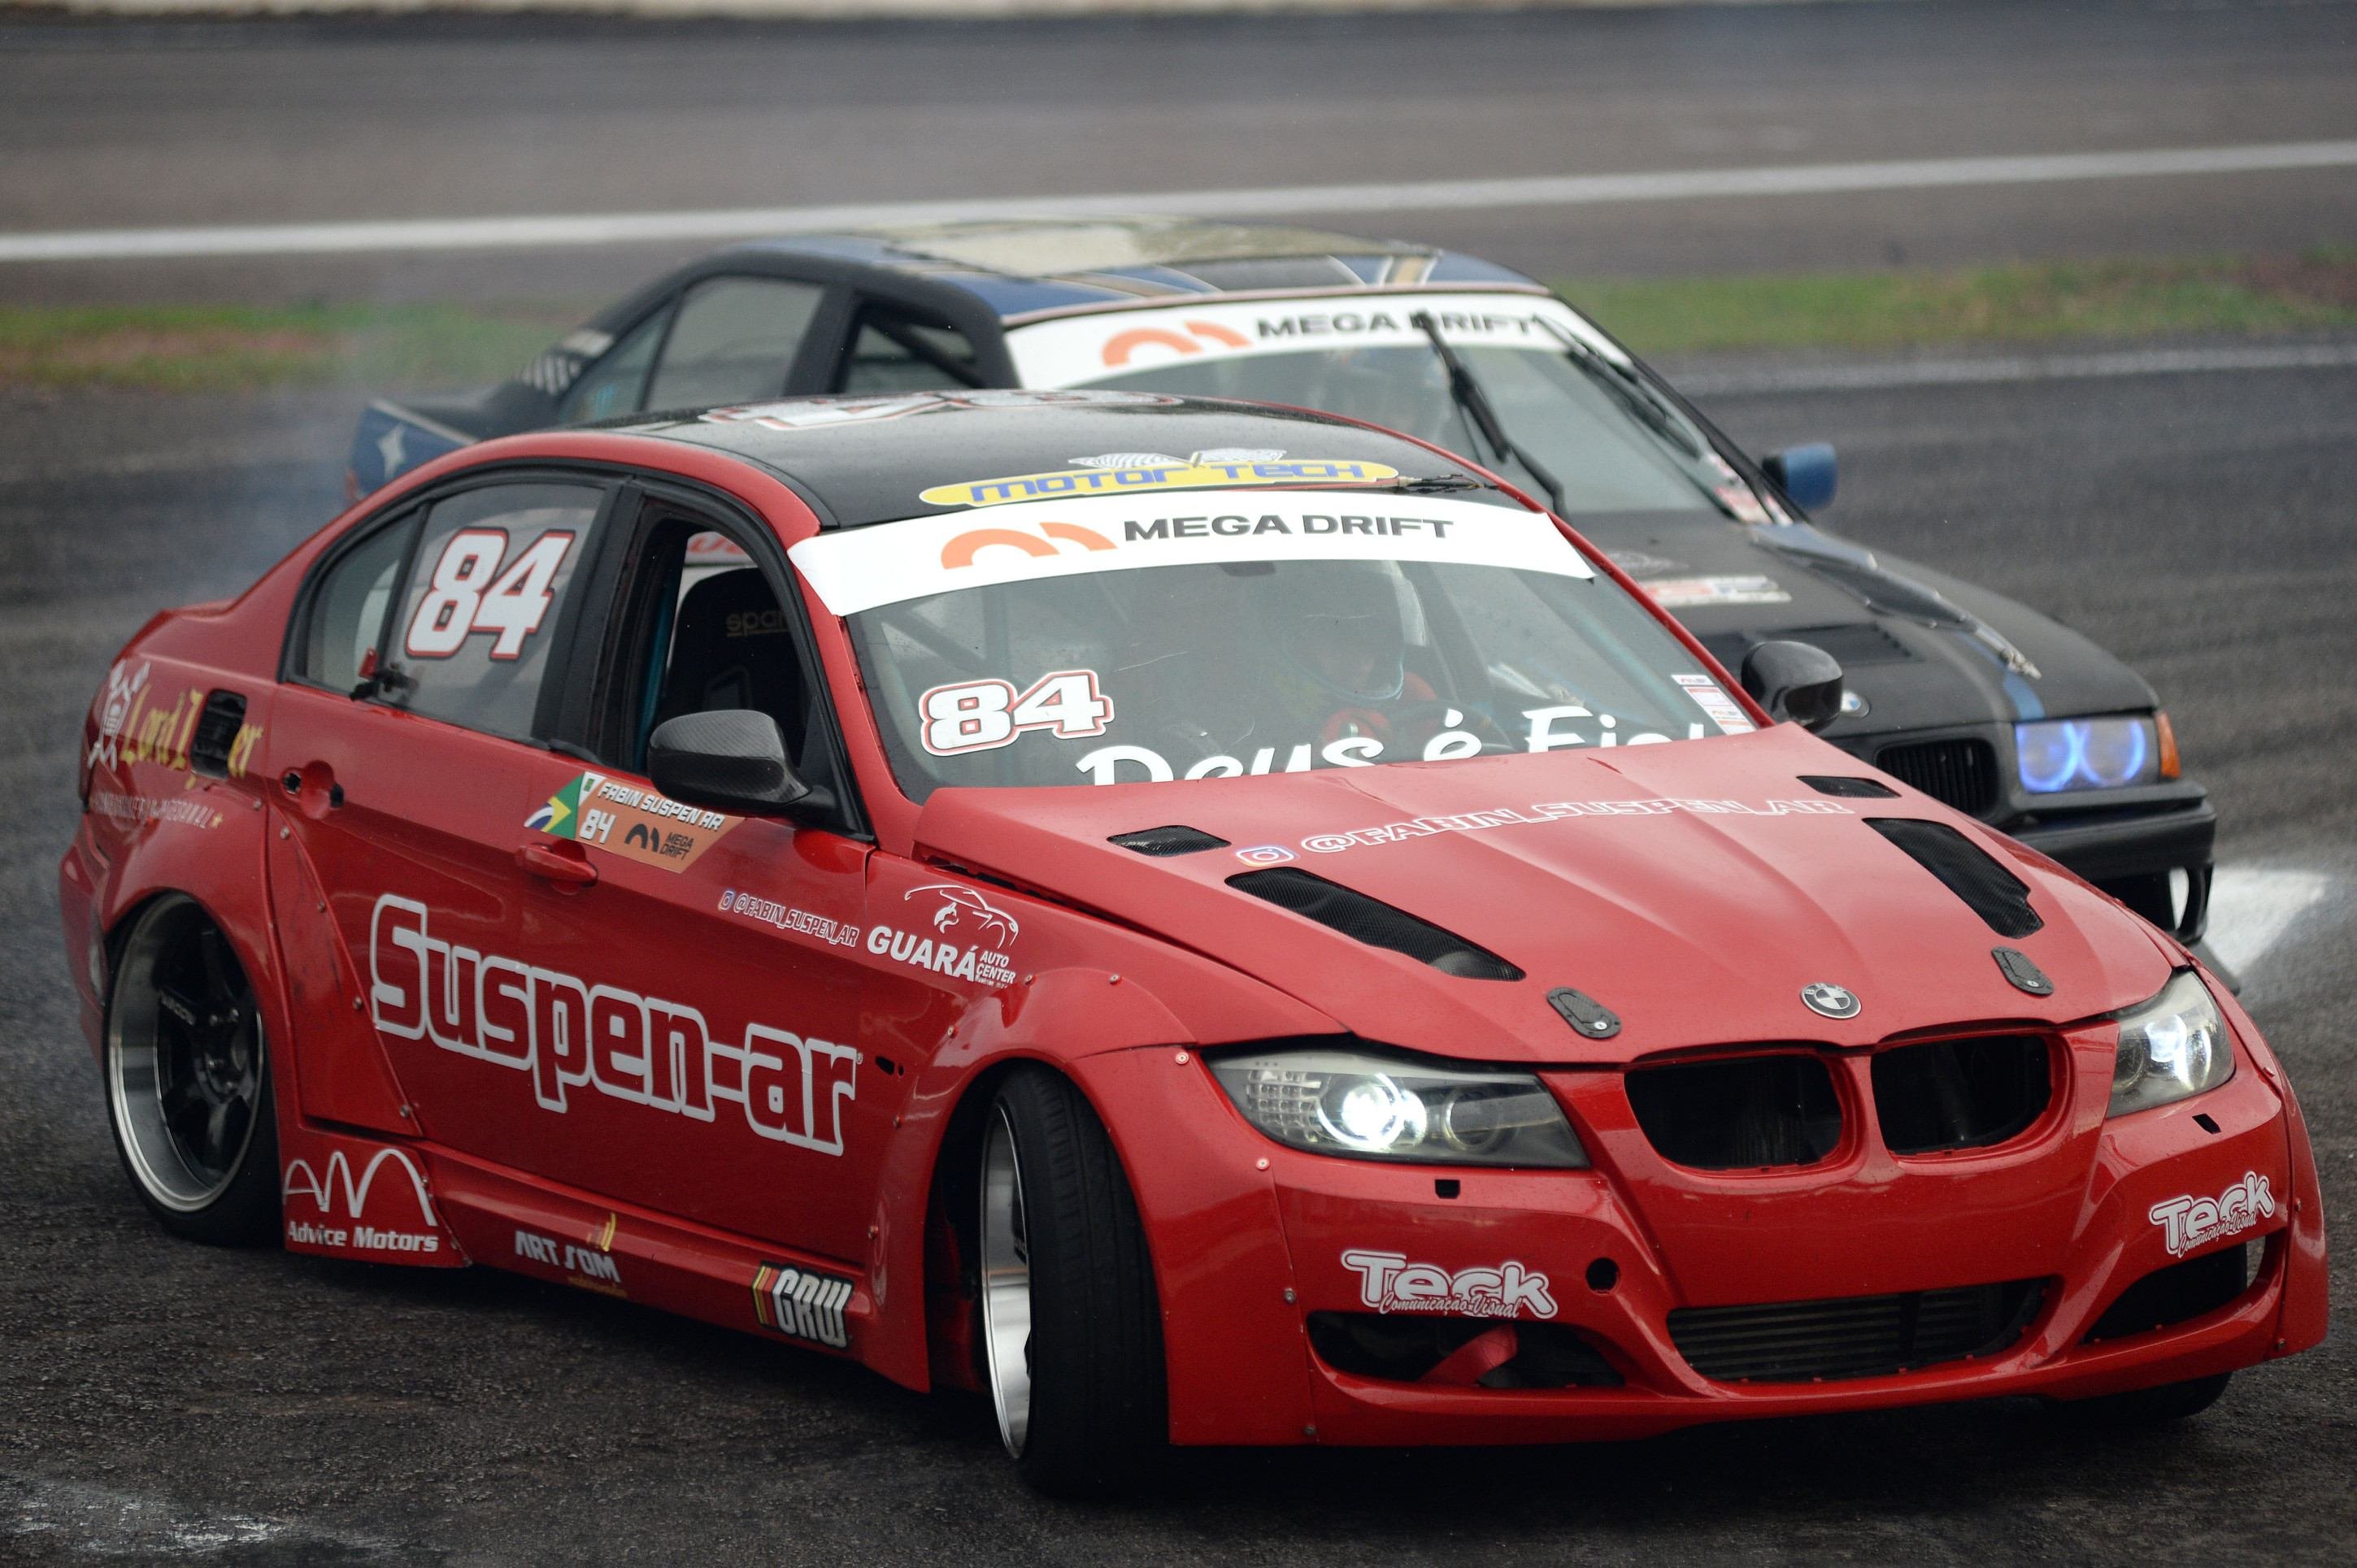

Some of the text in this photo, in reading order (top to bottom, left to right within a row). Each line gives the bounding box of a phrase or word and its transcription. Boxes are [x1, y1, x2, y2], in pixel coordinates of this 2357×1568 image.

[1257, 312, 1399, 338] MEGA
[1124, 515, 1455, 541] MEGA DRIFT
[405, 526, 576, 662] 84
[919, 670, 1115, 756] 84
[598, 781, 726, 832] FABIN SUSPEN AR
[579, 809, 616, 844] 84
[665, 832, 694, 848] MEGA
[659, 843, 690, 860] DRIFT
[867, 925, 980, 982] GUARÁ
[980, 950, 1009, 968] AUTO
[976, 964, 1016, 984] CENTER
[370, 894, 858, 1157] Suspen-ar
[287, 1220, 439, 1252] Advice Motors
[515, 1231, 559, 1266] ART
[1342, 1249, 1559, 1319] Teck
[772, 1268, 852, 1348] GRW
